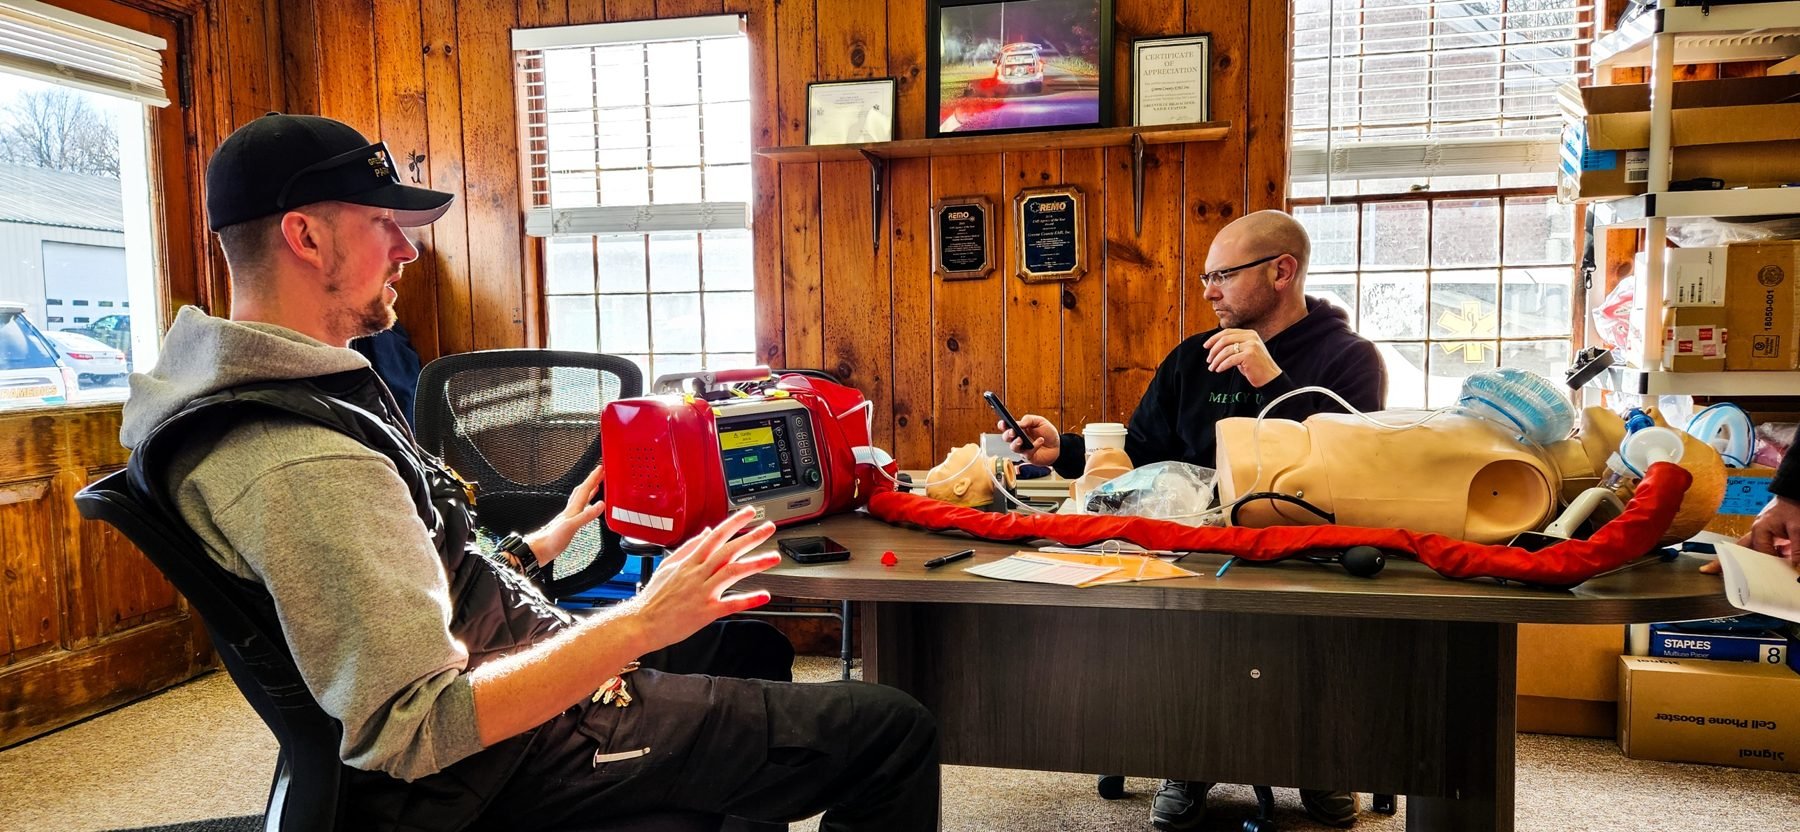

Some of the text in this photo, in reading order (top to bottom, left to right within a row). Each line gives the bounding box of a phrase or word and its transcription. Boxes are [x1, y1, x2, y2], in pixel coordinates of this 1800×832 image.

[1145, 52, 1194, 60] CERTIFICATE
[1144, 67, 1198, 76] APPRECIATION
[1040, 202, 1067, 212] REMO
[948, 211, 970, 219] REMO
[1765, 290, 1775, 331] 18050-001
[0, 385, 57, 398] RAMEDICS
[1664, 639, 1711, 650] STAPLES
[1767, 647, 1780, 664] 8
[1654, 712, 1777, 730] Cell Phone Booster
[1739, 748, 1784, 761] Signal
